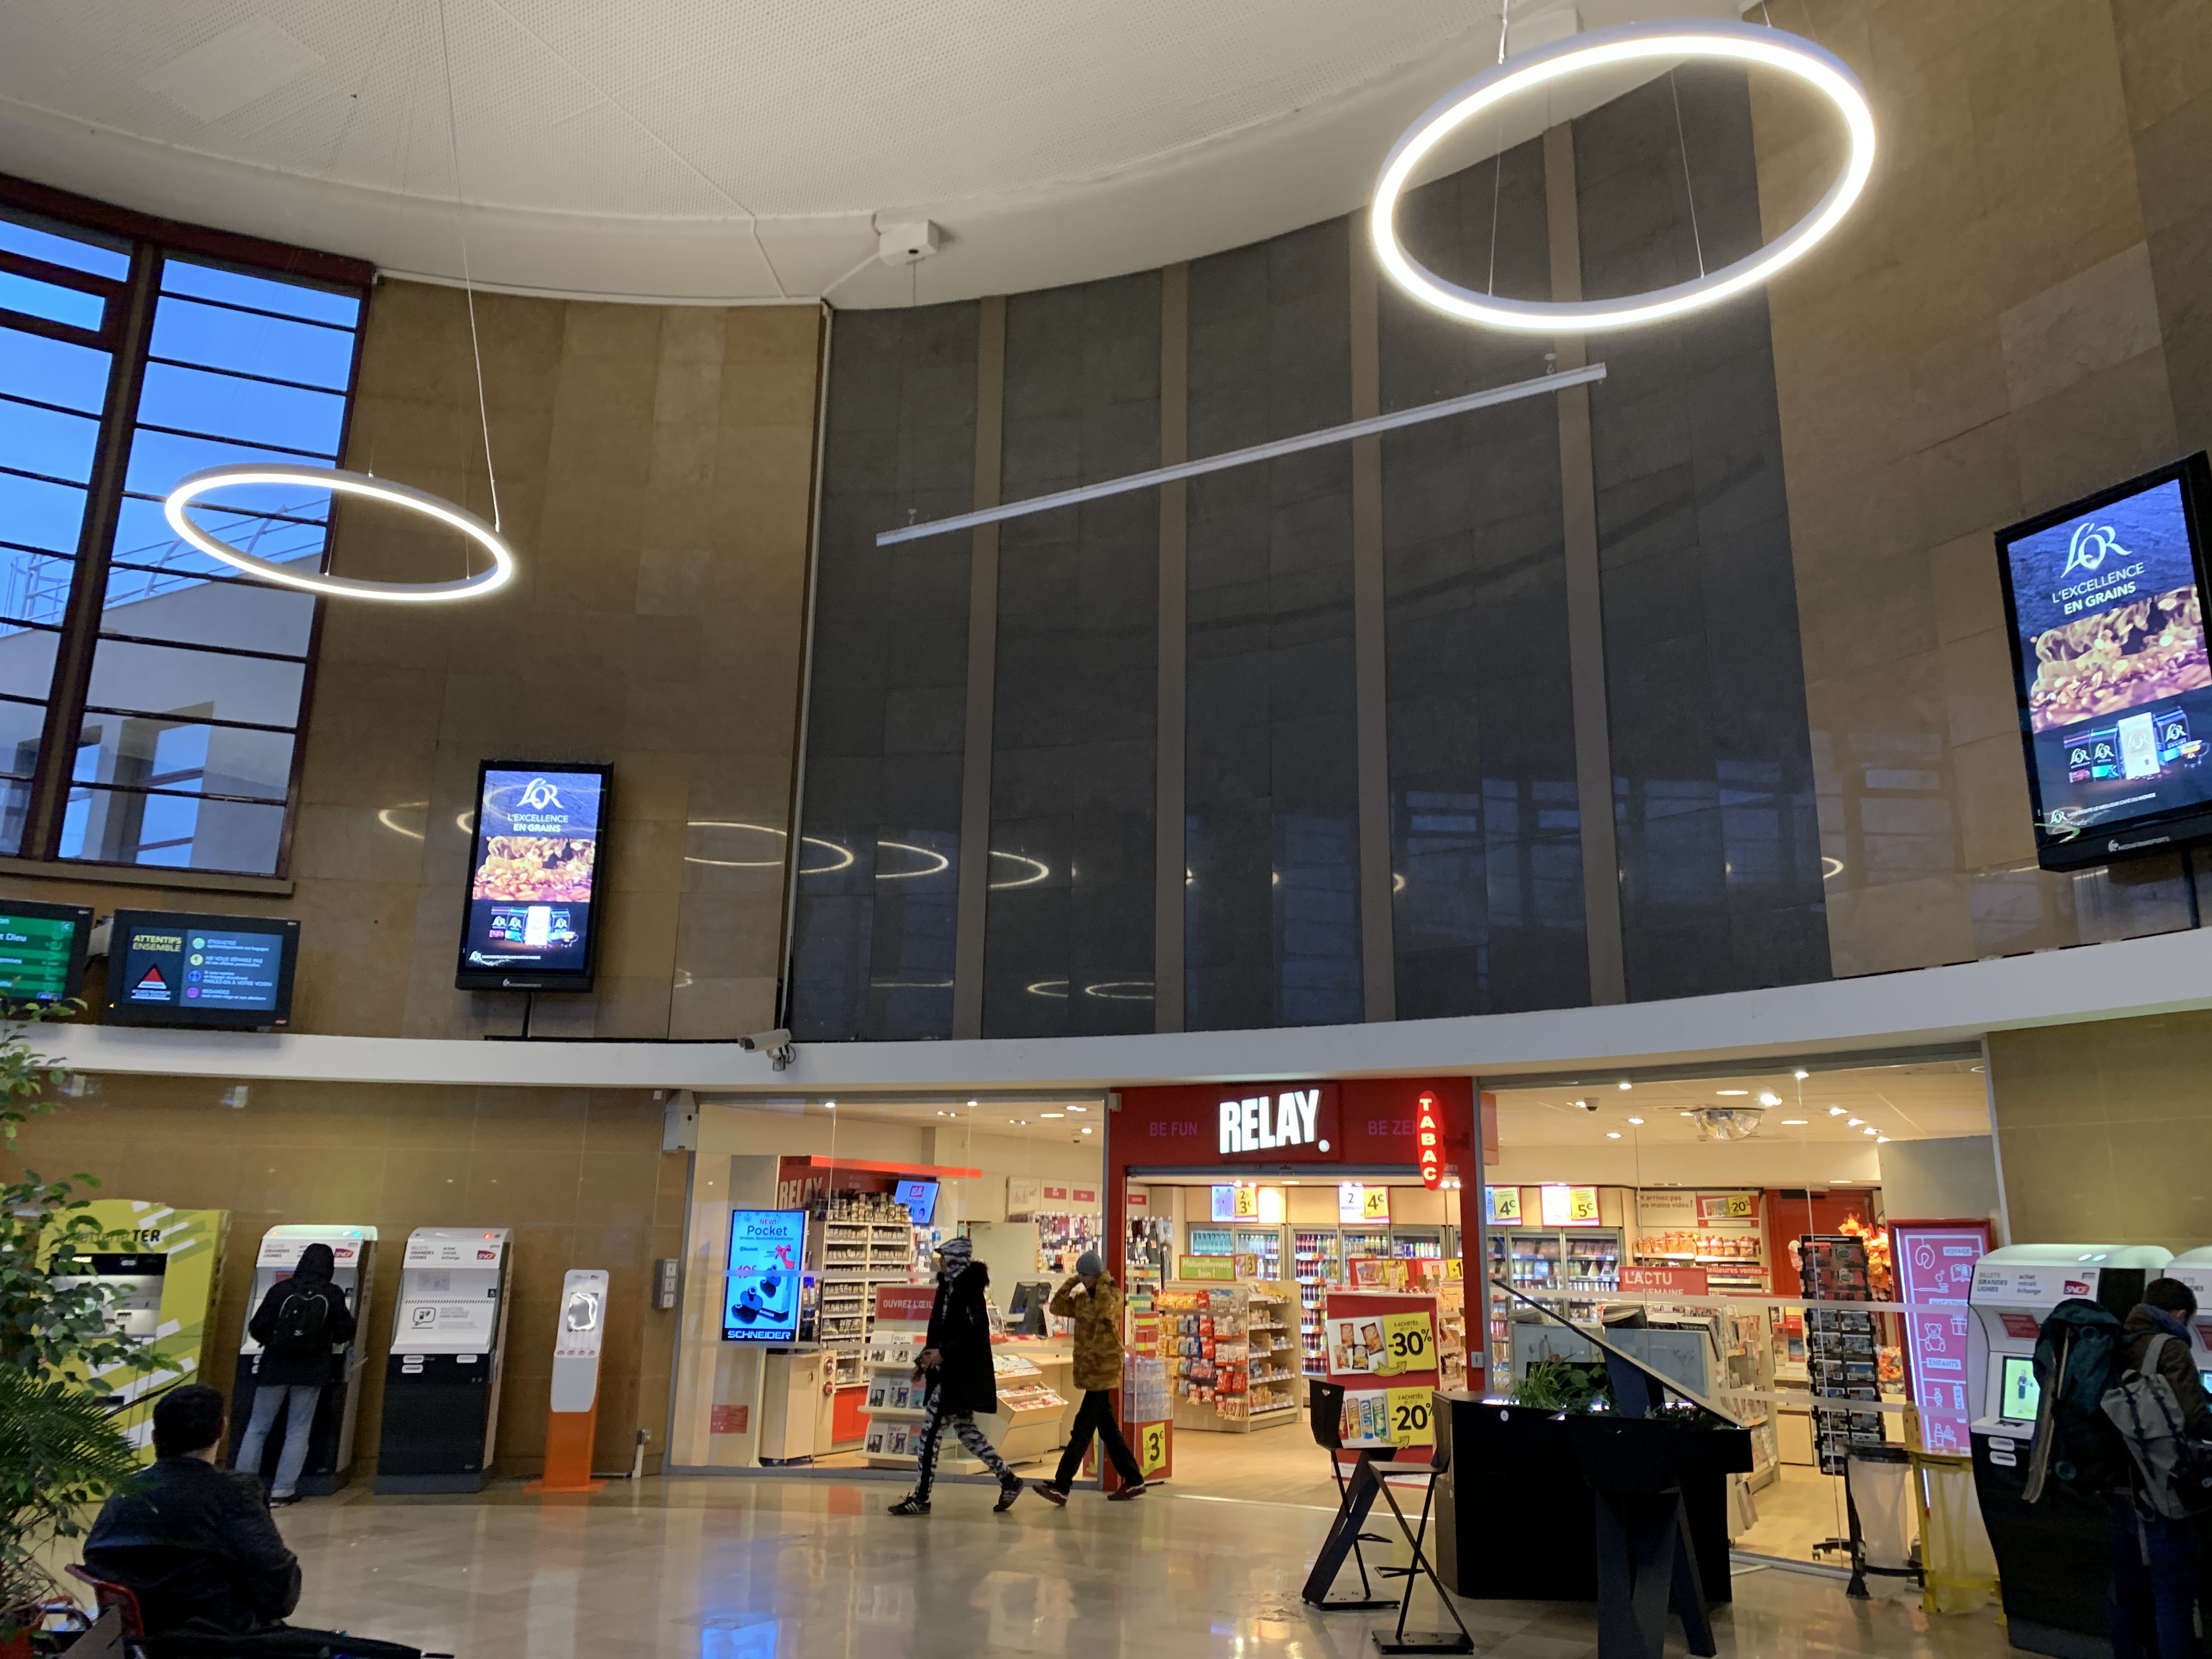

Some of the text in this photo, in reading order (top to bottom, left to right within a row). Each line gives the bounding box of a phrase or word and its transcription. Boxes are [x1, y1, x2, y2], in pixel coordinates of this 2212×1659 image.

[2061, 522, 2132, 578] L'OR
[2052, 562, 2145, 603] L'EXCELLENCE
[2064, 582, 2136, 615] EN GRAINS
[516, 777, 564, 809] L'OR
[507, 814, 568, 823] L'EXCELLENCE
[513, 824, 561, 833] EN GRAINS
[133, 935, 182, 944] ATTENTIFS
[133, 943, 182, 952] ENSEMBLE
[1149, 1121, 1197, 1136] BE FUN
[1368, 1120, 1387, 1136] BE
[1419, 1098, 1437, 1181] TABAC
[1240, 1190, 1245, 1200] 2
[1348, 1193, 1354, 1203] 2
[747, 1225, 787, 1235] Pocket
[132, 1229, 161, 1243] TER
[1182, 1258, 1232, 1268] Naturellement
[1198, 1269, 1211, 1278] bon
[1624, 1271, 1673, 1285] L'ACTU
[2064, 1285, 2088, 1294] SNCF
[883, 1299, 912, 1308] OUVREZ
[727, 1330, 791, 1339] SCHNEIDER
[1389, 1329, 1432, 1357] -30%
[1929, 1359, 1959, 1368] ENFANTS
